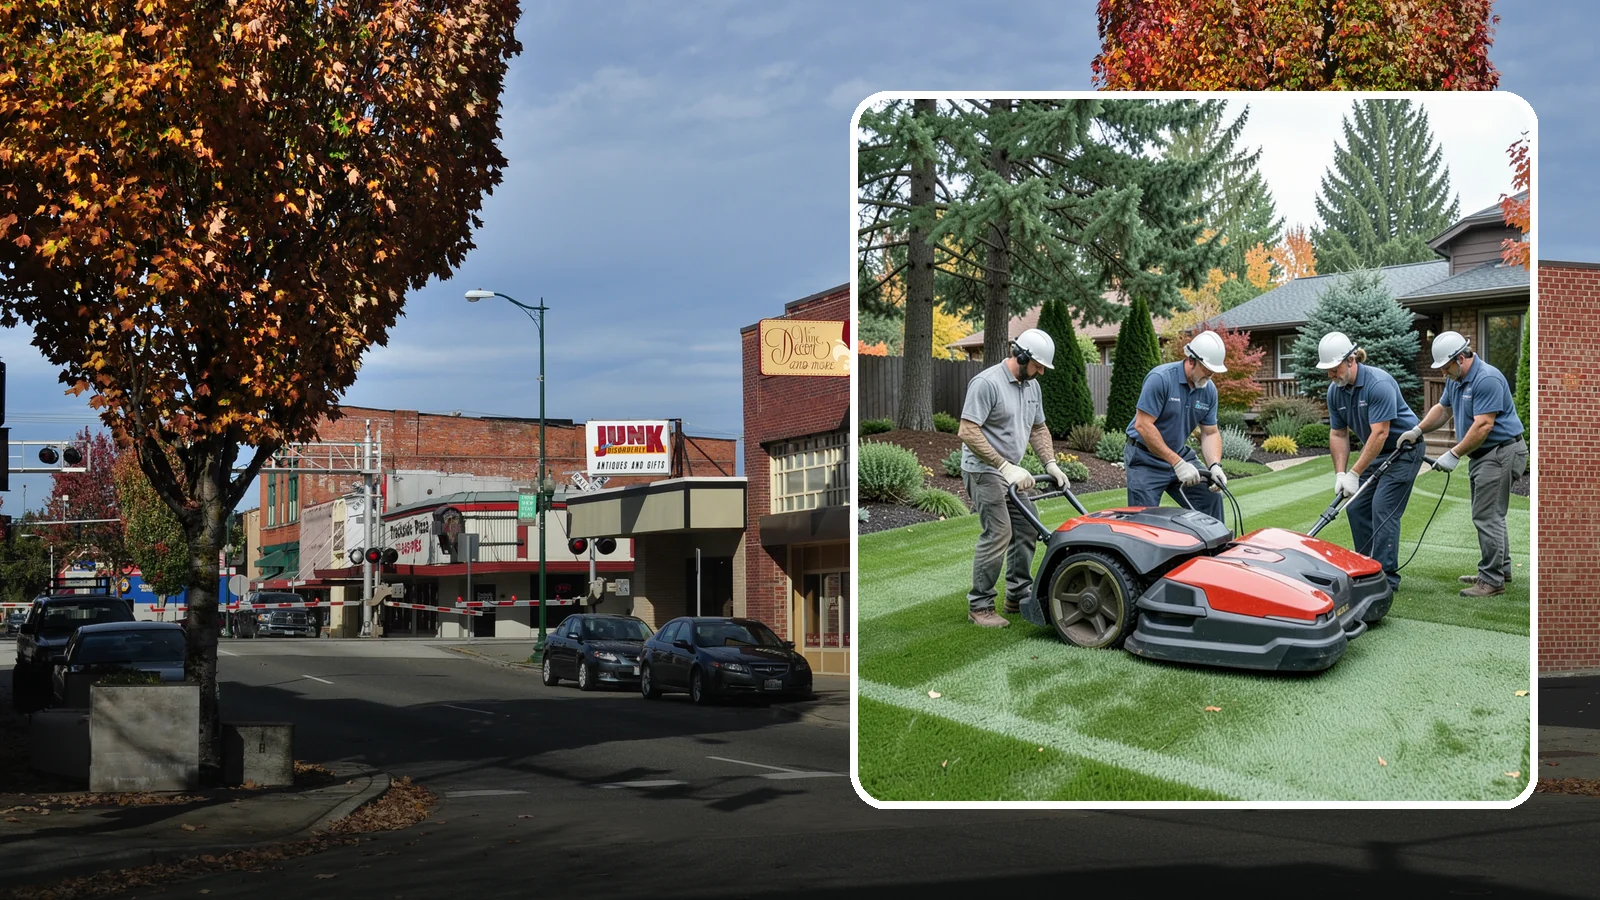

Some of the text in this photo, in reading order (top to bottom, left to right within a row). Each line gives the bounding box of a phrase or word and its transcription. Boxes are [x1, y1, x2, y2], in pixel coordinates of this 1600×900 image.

[595, 425, 665, 457] JUNK
[607, 446, 646, 454] DISORDERLY
[597, 460, 665, 470] ANTIQUES AND GIFTS
[352, 498, 365, 511] CRO
[415, 519, 429, 535] Pizza
